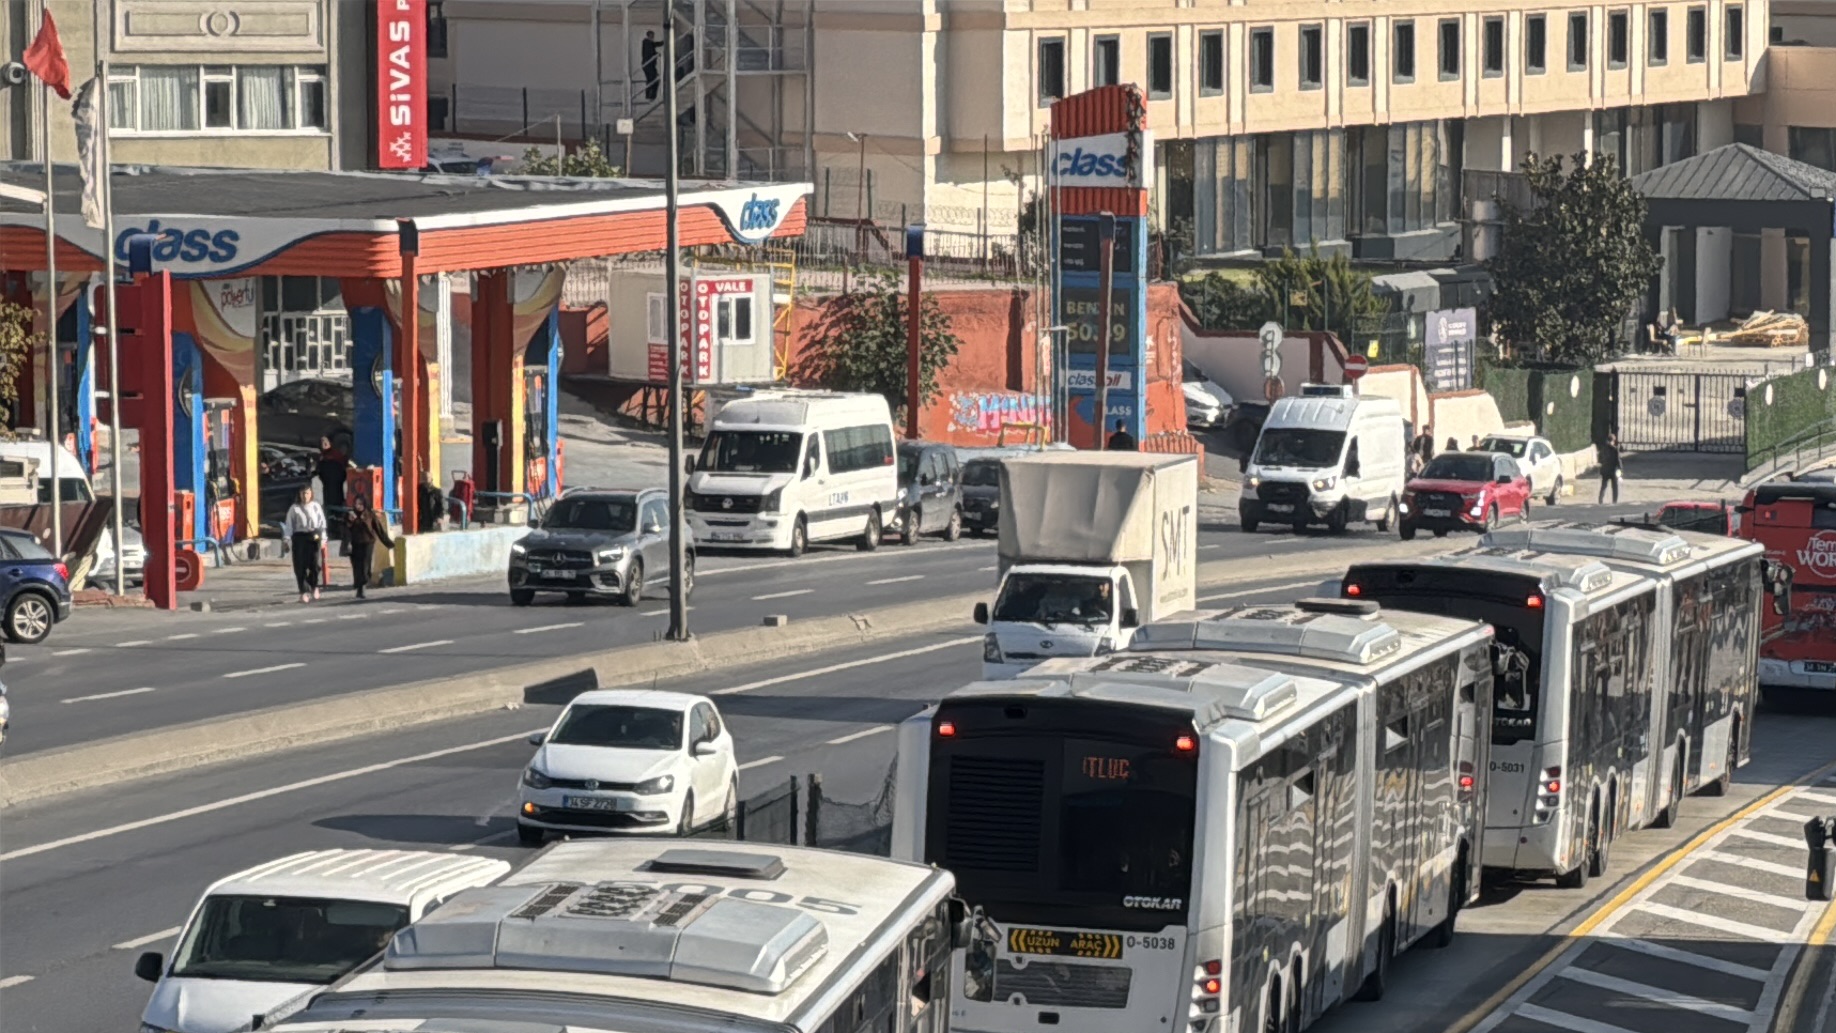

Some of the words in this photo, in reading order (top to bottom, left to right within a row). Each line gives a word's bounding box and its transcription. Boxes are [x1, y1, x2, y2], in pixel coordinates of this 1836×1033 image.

[715, 282, 746, 292] VALE
[680, 282, 689, 376] OTOPARK
[698, 283, 709, 377] OTOPARK
[1161, 505, 1190, 581] SMT
[1123, 895, 1182, 910] OTOKAR
[1027, 936, 1060, 948] UZUN
[1070, 939, 1103, 952] ARAÇ
